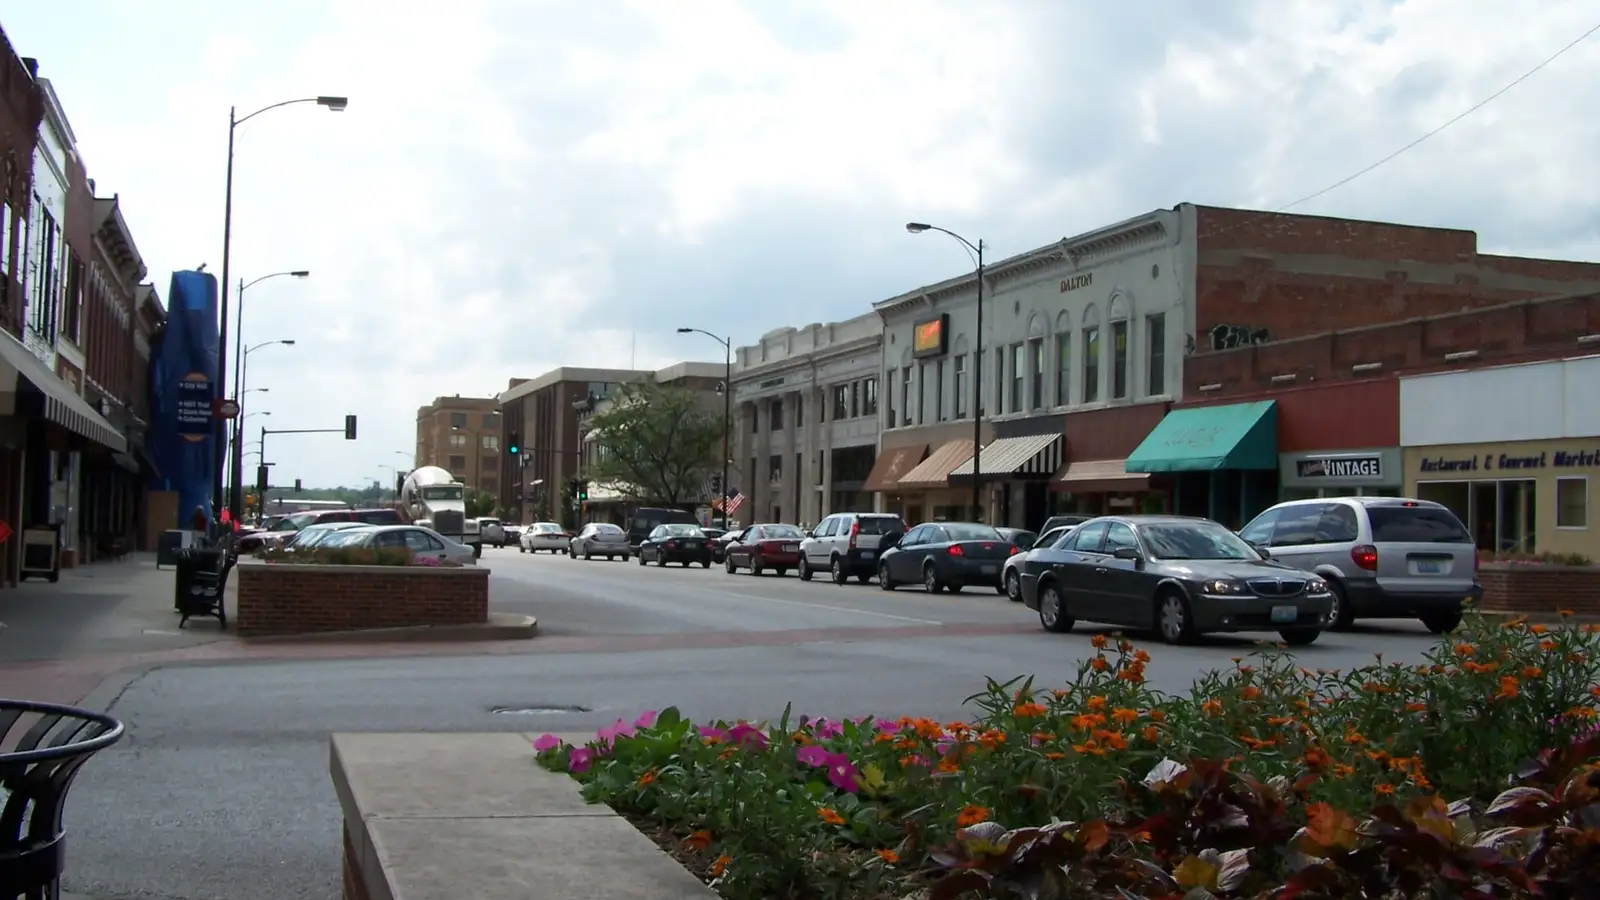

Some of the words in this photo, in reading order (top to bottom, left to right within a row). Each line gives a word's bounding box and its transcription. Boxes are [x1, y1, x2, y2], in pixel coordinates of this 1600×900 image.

[1060, 272, 1092, 293] DALTON
[1322, 459, 1378, 476] VINTAGE
[1420, 454, 1478, 472] Restaurant
[1498, 452, 1546, 469] Gourmet
[1553, 449, 1600, 467] Market
